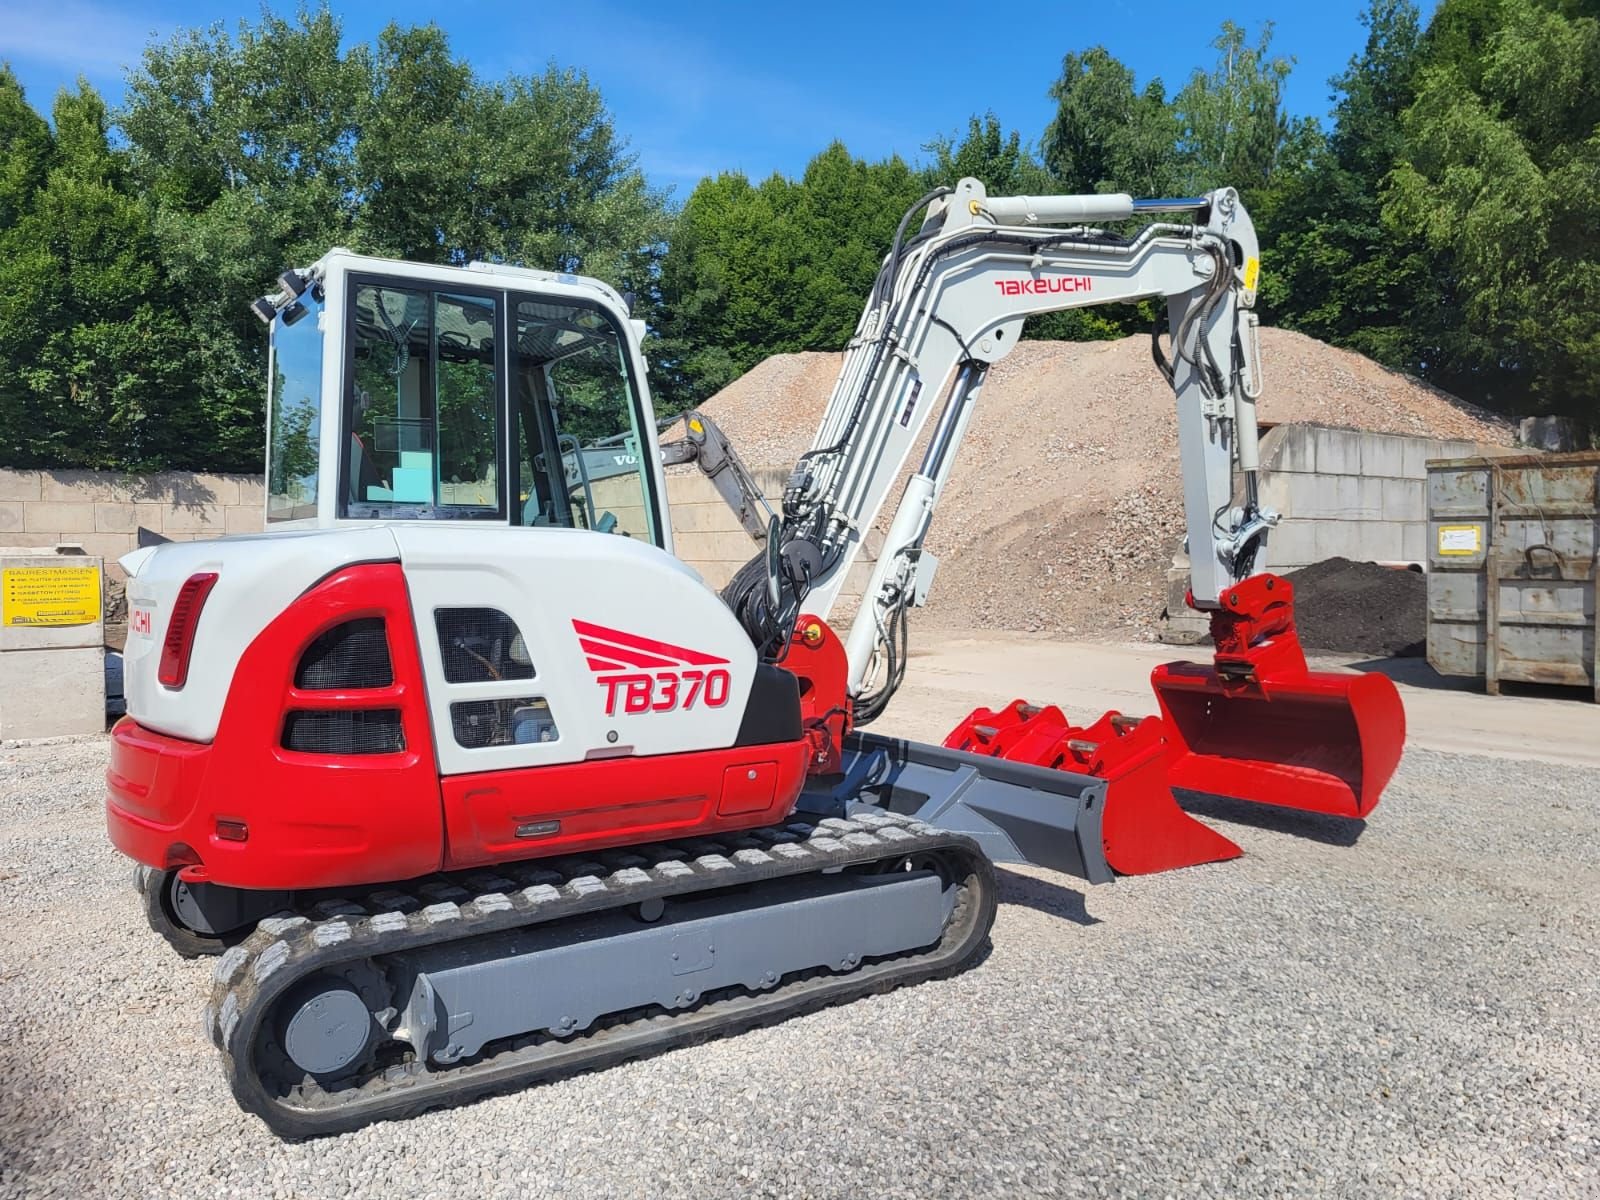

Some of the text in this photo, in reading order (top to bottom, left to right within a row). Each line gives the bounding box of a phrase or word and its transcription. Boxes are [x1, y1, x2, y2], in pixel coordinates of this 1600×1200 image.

[995, 277, 1091, 295] TAKEUCHI
[613, 450, 666, 465] VOO
[596, 669, 731, 717] TB370
